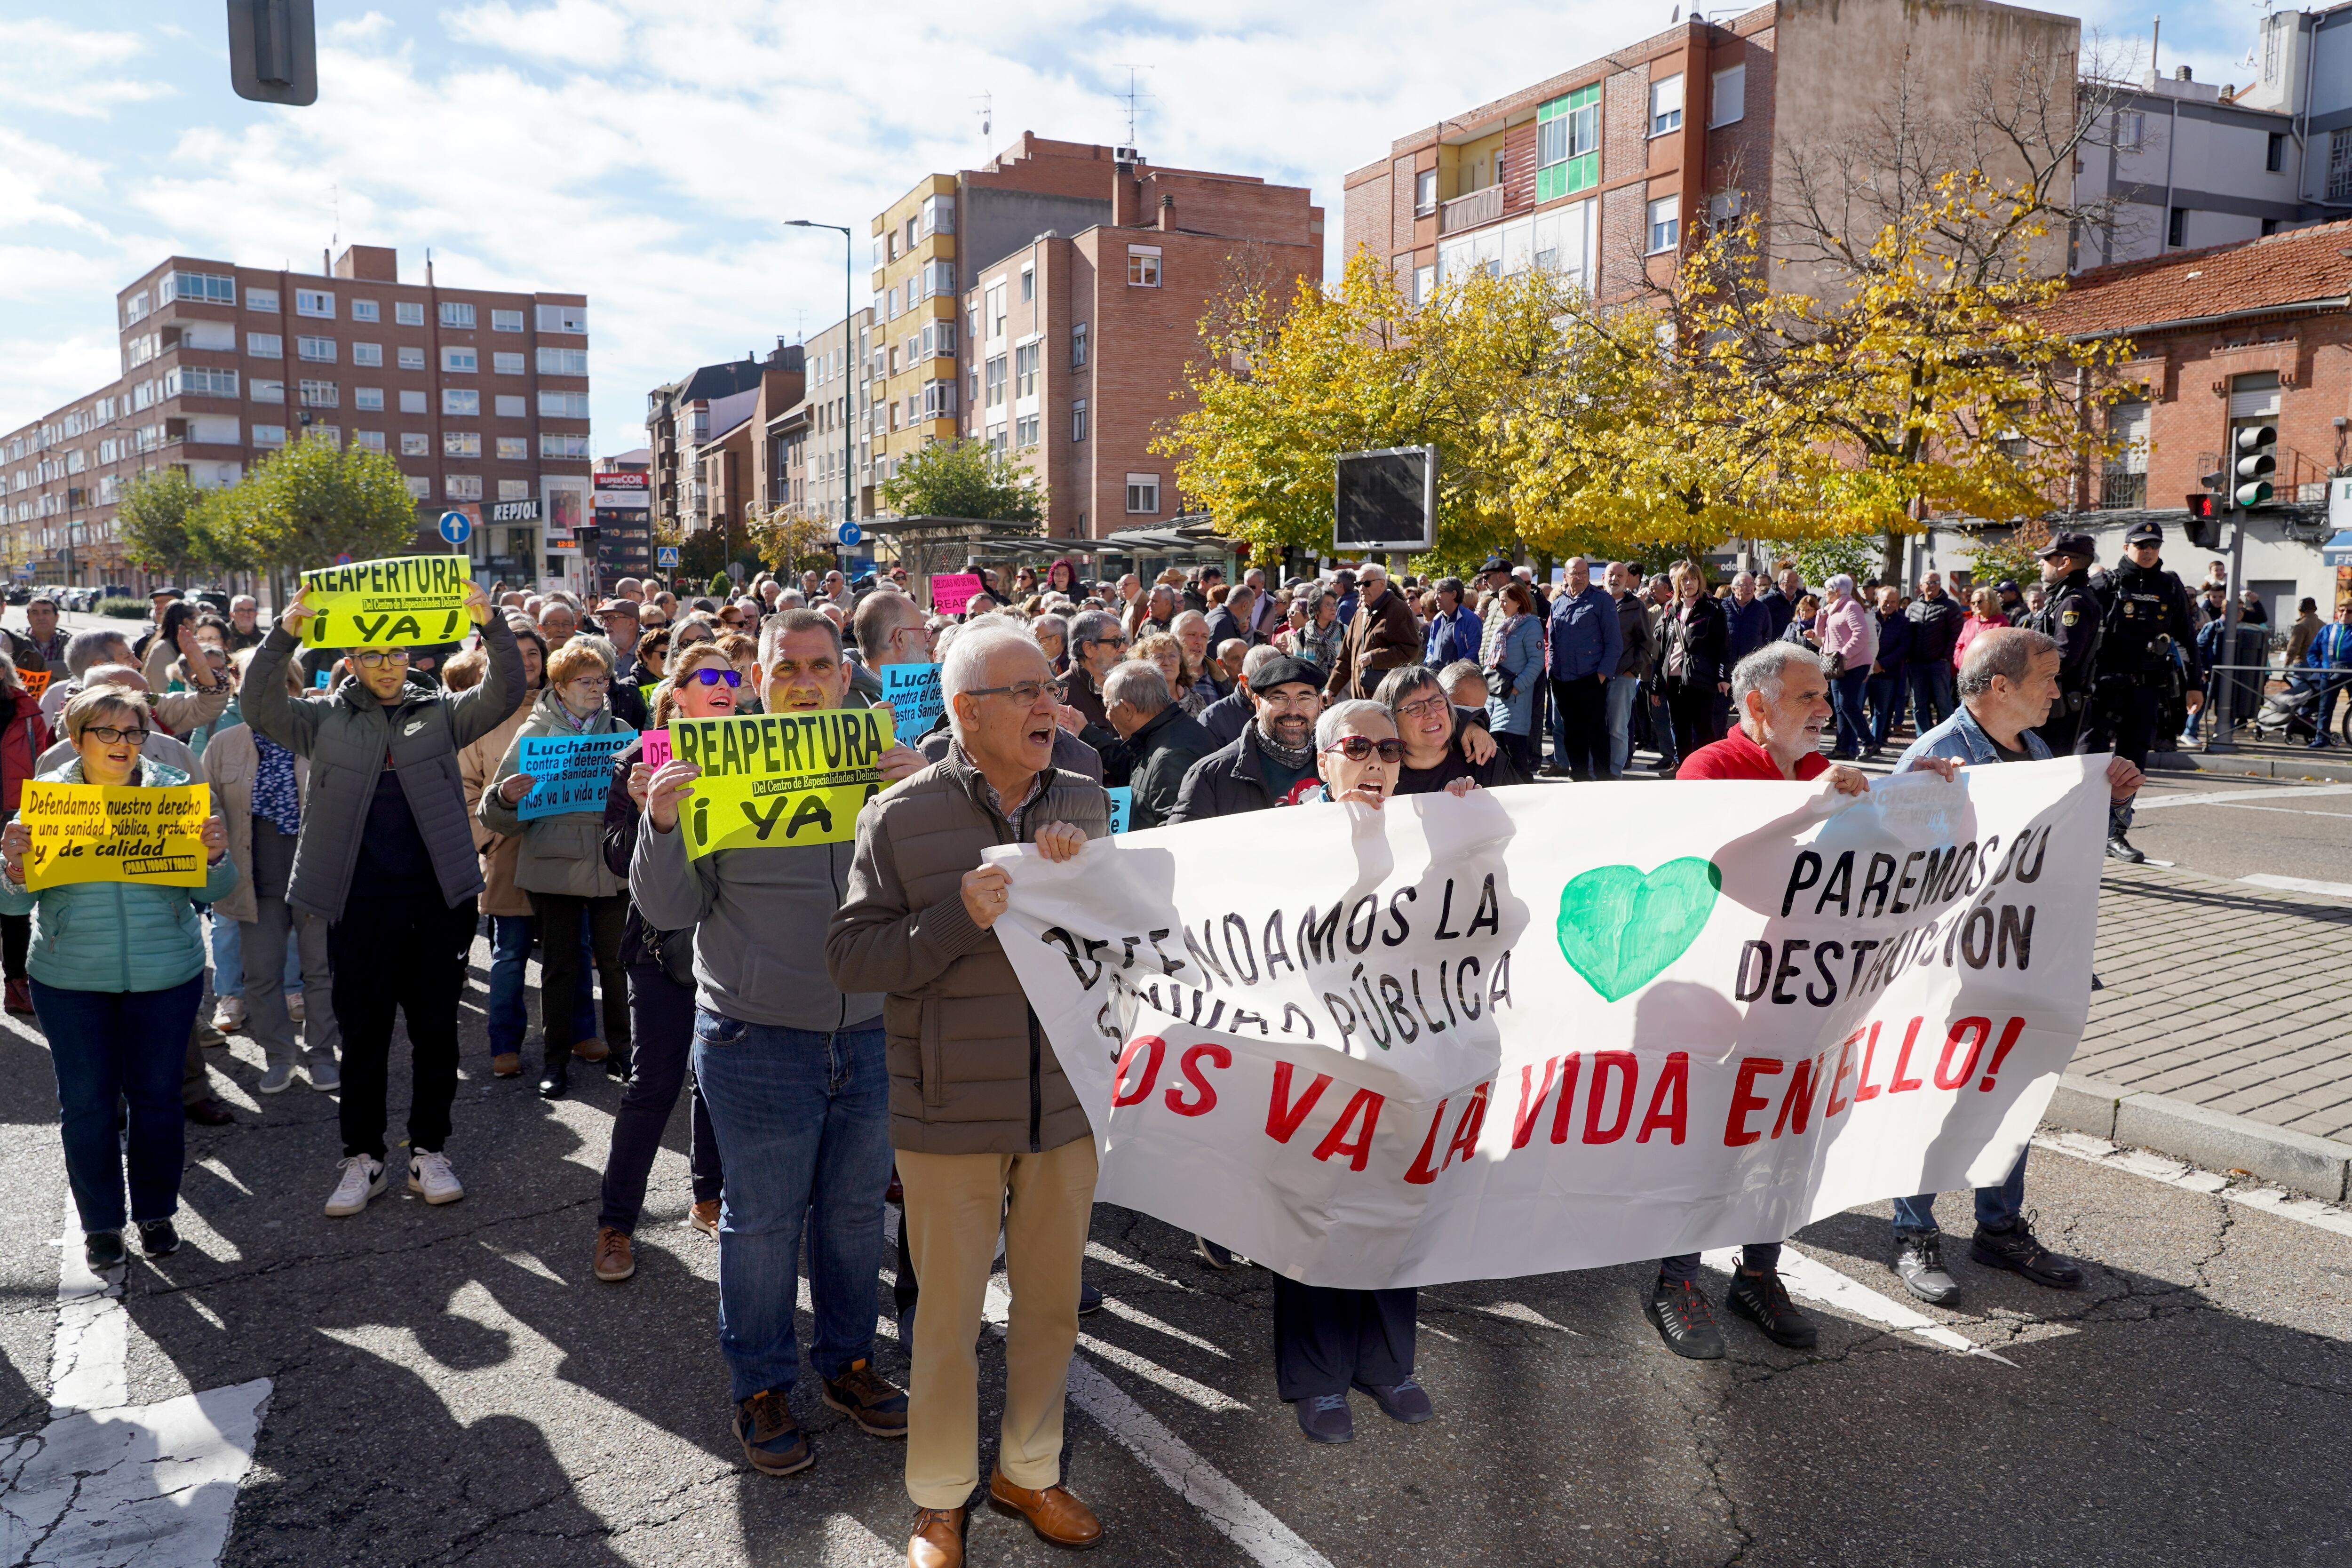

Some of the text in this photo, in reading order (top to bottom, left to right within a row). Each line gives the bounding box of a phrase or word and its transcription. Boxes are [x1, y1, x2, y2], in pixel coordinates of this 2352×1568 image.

[494, 501, 537, 520] REPSOL
[309, 558, 461, 594] REAPERTURA
[933, 579, 953, 589] DELICIAS
[953, 578, 961, 587] NO
[961, 578, 967, 587] SE
[363, 596, 461, 611] Del Centro de Especialidades Delicias
[936, 597, 970, 609] REAB
[353, 614, 421, 642] YA
[890, 669, 942, 688] Luch
[889, 689, 918, 706] contra
[919, 685, 929, 703] el
[406, 721, 421, 731] NIKE
[678, 713, 883, 778] REAPERTURA
[526, 756, 559, 772] contra
[563, 754, 572, 768] el
[562, 767, 597, 781] Sanidad
[525, 789, 542, 810] Nos
[547, 791, 557, 806] va
[562, 783, 569, 804] la
[574, 780, 592, 802] vida
[753, 780, 767, 795] Del
[767, 779, 792, 794] Centro
[794, 777, 802, 788] de
[803, 772, 854, 789] Especialidades
[28, 790, 201, 816] Defendamos nuestro derecho
[39, 824, 58, 836] una
[64, 817, 105, 836] sanidad
[111, 816, 150, 840] pública,
[157, 820, 201, 839] gratuita
[739, 795, 832, 841] YA
[35, 838, 166, 866] y de calidad
[145, 858, 168, 871] TODOS
[1781, 824, 2052, 918] PAREMOS SU
[1434, 873, 1499, 940] LA
[1323, 950, 1512, 1055] PÚBLICA
[1264, 1060, 1386, 1173] VA
[1403, 1080, 1491, 1186] LA
[1511, 1050, 1689, 1150] VIDA
[1723, 1051, 1824, 1147] EN
[1825, 1015, 2026, 1119] ELLO!
